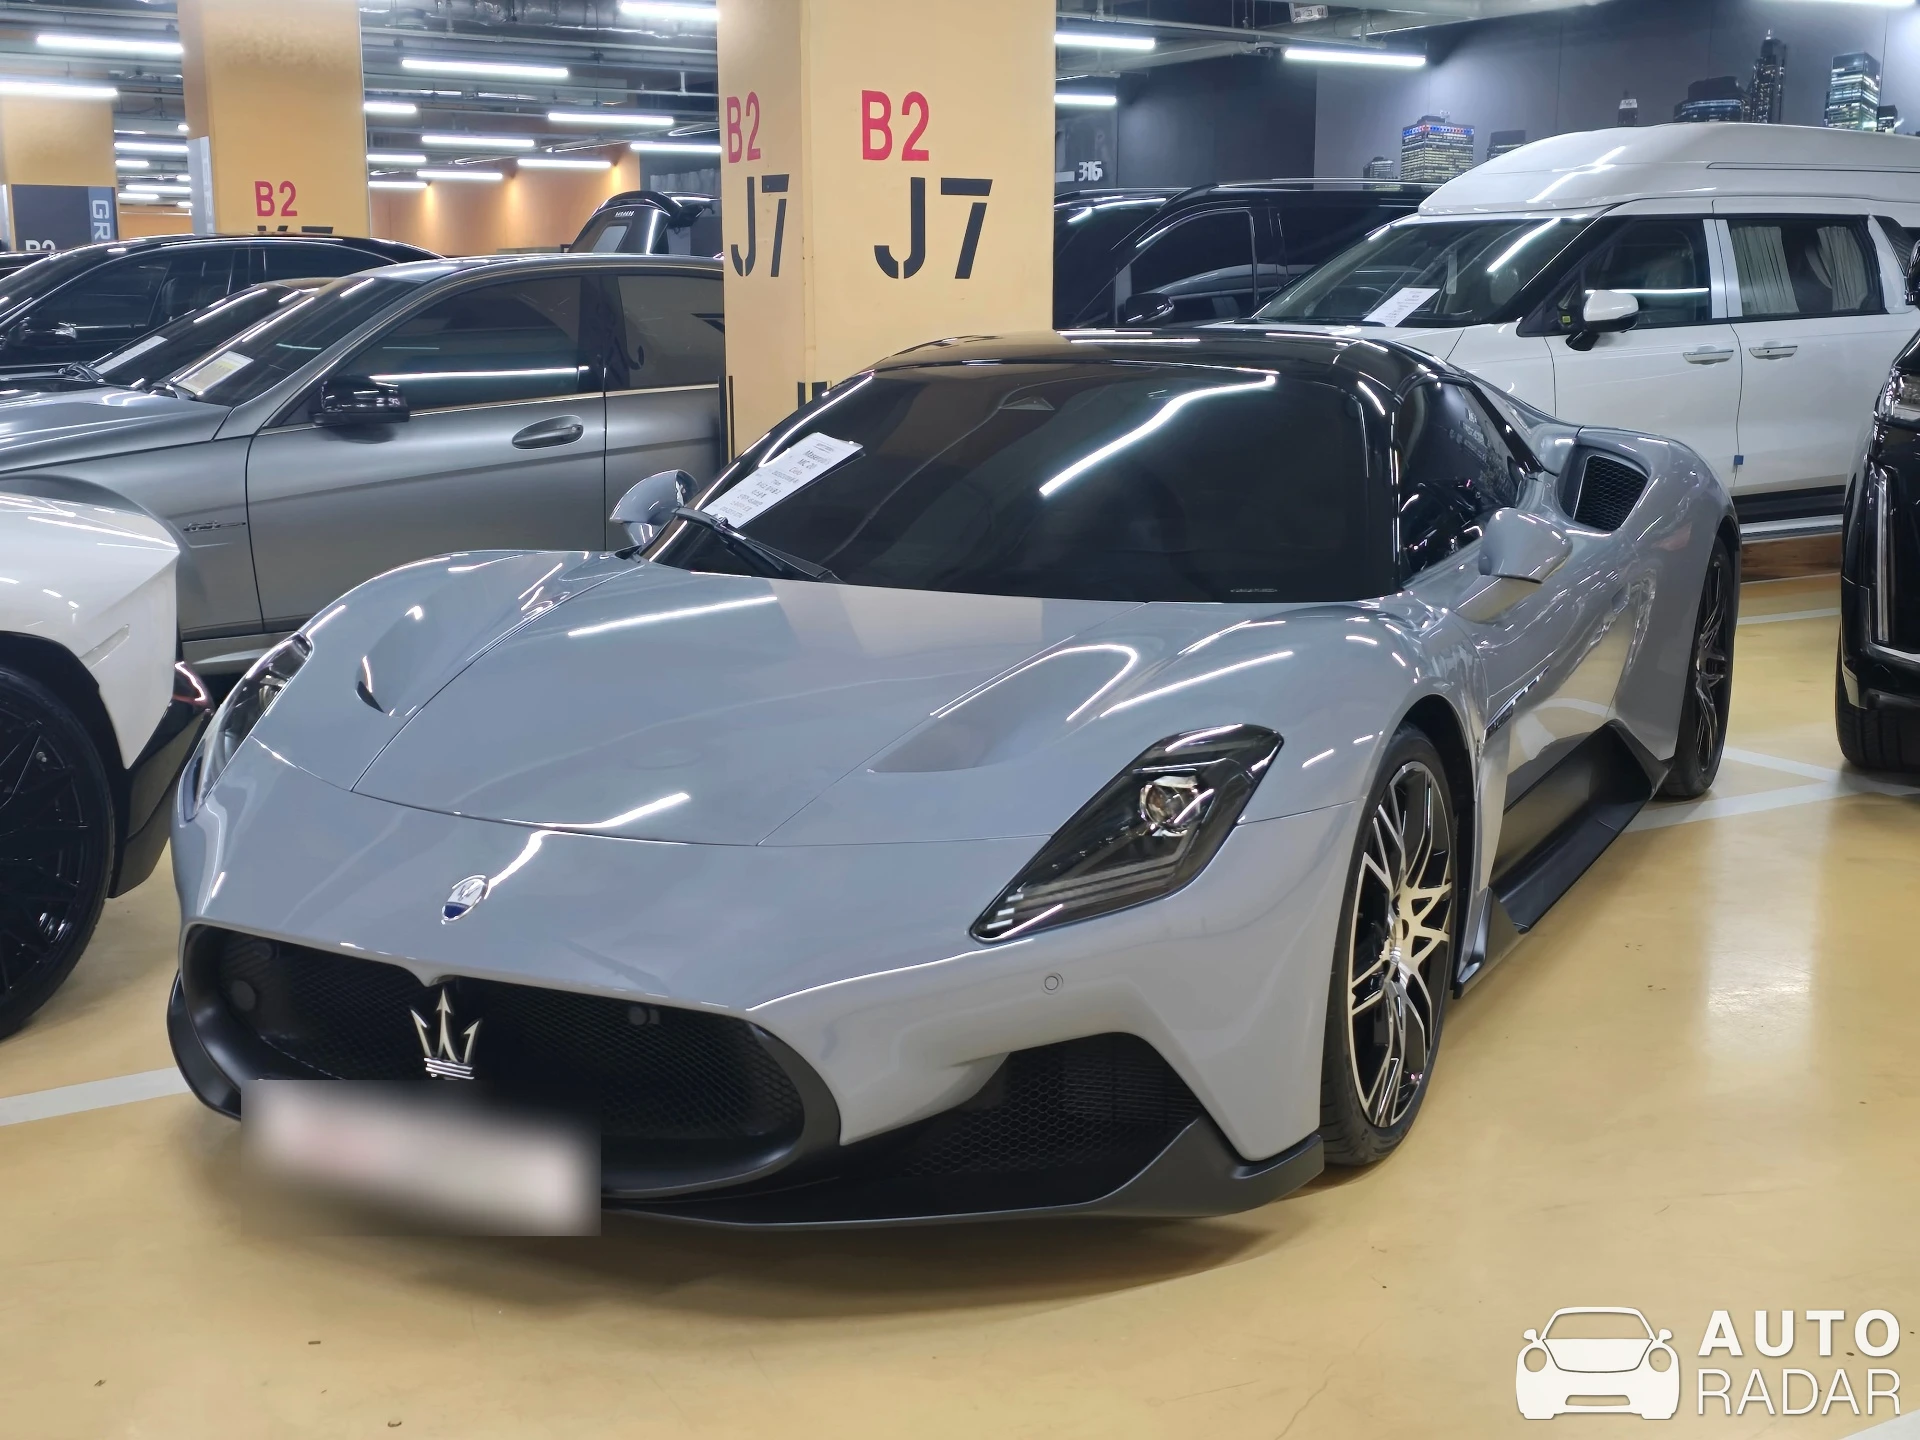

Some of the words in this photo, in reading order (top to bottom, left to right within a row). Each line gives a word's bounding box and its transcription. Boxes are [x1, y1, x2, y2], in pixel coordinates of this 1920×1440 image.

[726, 91, 761, 164] B2
[861, 89, 930, 162] B2
[254, 180, 299, 217] B2
[730, 173, 790, 278] J7
[873, 176, 994, 280] J7
